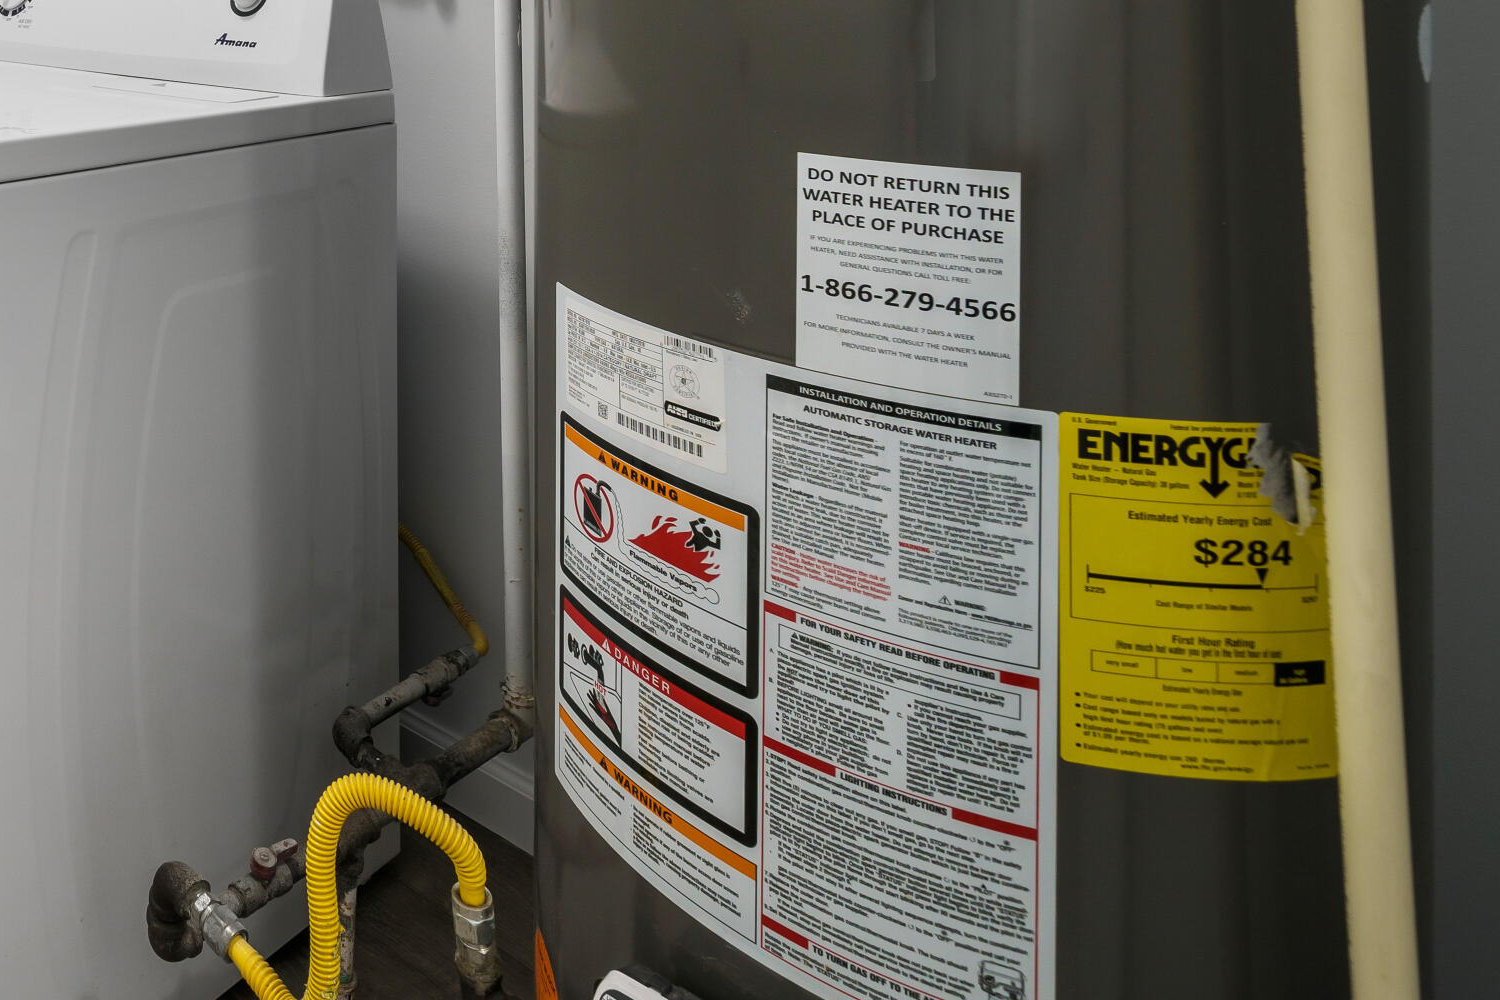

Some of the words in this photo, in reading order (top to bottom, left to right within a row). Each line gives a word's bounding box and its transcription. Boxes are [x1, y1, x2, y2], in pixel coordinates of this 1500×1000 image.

[214, 32, 258, 48] Amana
[808, 168, 834, 182] DO
[840, 172, 878, 187] NOT
[884, 176, 960, 196] RETURN
[966, 184, 1010, 200] THIS
[802, 188, 864, 207] WATER
[870, 196, 940, 216] HEATER
[946, 204, 972, 218] TO
[977, 206, 1015, 222] THE
[812, 210, 866, 228] PLACE
[872, 218, 896, 232] OF
[902, 222, 1004, 244] PURCHASE
[838, 250, 857, 258] NEED
[858, 253, 898, 264] ASSISTANCE
[922, 262, 972, 274] INSTALLATION,
[847, 240, 897, 252] EXPERIENCING
[898, 248, 937, 258] PROBLEMS
[978, 256, 1004, 264] WATER
[802, 275, 1016, 322] 1-866-279-4566
[836, 314, 882, 326] TECHNICIANS
[882, 322, 918, 334] AVAILABLE
[818, 324, 838, 332] MORE
[892, 337, 924, 348] CONSULT
[942, 345, 976, 355] OWNER'S
[978, 350, 1012, 360] MANUAL
[842, 342, 876, 352] PROVIDED
[878, 348, 897, 356] WITH
[914, 354, 938, 363] WATER
[941, 359, 968, 368] HEATER
[800, 386, 868, 408] INSTALLATION
[870, 402, 892, 412] AND
[896, 408, 955, 424] OPERATION
[958, 418, 1002, 432] DETAILS
[804, 405, 862, 424] AUTOMATIC
[864, 419, 914, 435] STORAGE
[915, 429, 952, 442] WATER
[954, 436, 997, 450] HEATER
[612, 458, 678, 502] WARNING
[1128, 510, 1178, 524] Estimated
[1182, 514, 1214, 526] Yearly
[1217, 516, 1250, 528] Energy
[1252, 516, 1272, 526] Cost
[1194, 538, 1292, 568] $284
[594, 547, 606, 559] FIRE
[606, 556, 618, 568] AND
[619, 565, 652, 590] EXPLOSION
[654, 588, 683, 608] HAZARD
[630, 550, 667, 576] Flammable
[670, 572, 697, 592] Vapors
[801, 616, 816, 628] FOR
[819, 624, 842, 638] YOUR
[844, 631, 876, 648] SAFETY
[880, 644, 902, 657] READ
[906, 650, 940, 668] BEFORE
[944, 660, 996, 680] OPERATING
[1172, 634, 1194, 646] First
[1198, 637, 1221, 647] Hour
[1224, 638, 1256, 648] Rating
[594, 680, 608, 696] HOT
[614, 649, 670, 695] DANGER
[614, 771, 673, 824] WARNING
[840, 772, 880, 793] LIGHTING
[882, 788, 948, 816] INSTRUCTIONS
[812, 945, 824, 958] TO
[826, 951, 848, 969] TURN
[851, 962, 868, 978] GAS
[870, 972, 887, 986] OFF
[890, 980, 901, 992] TO
